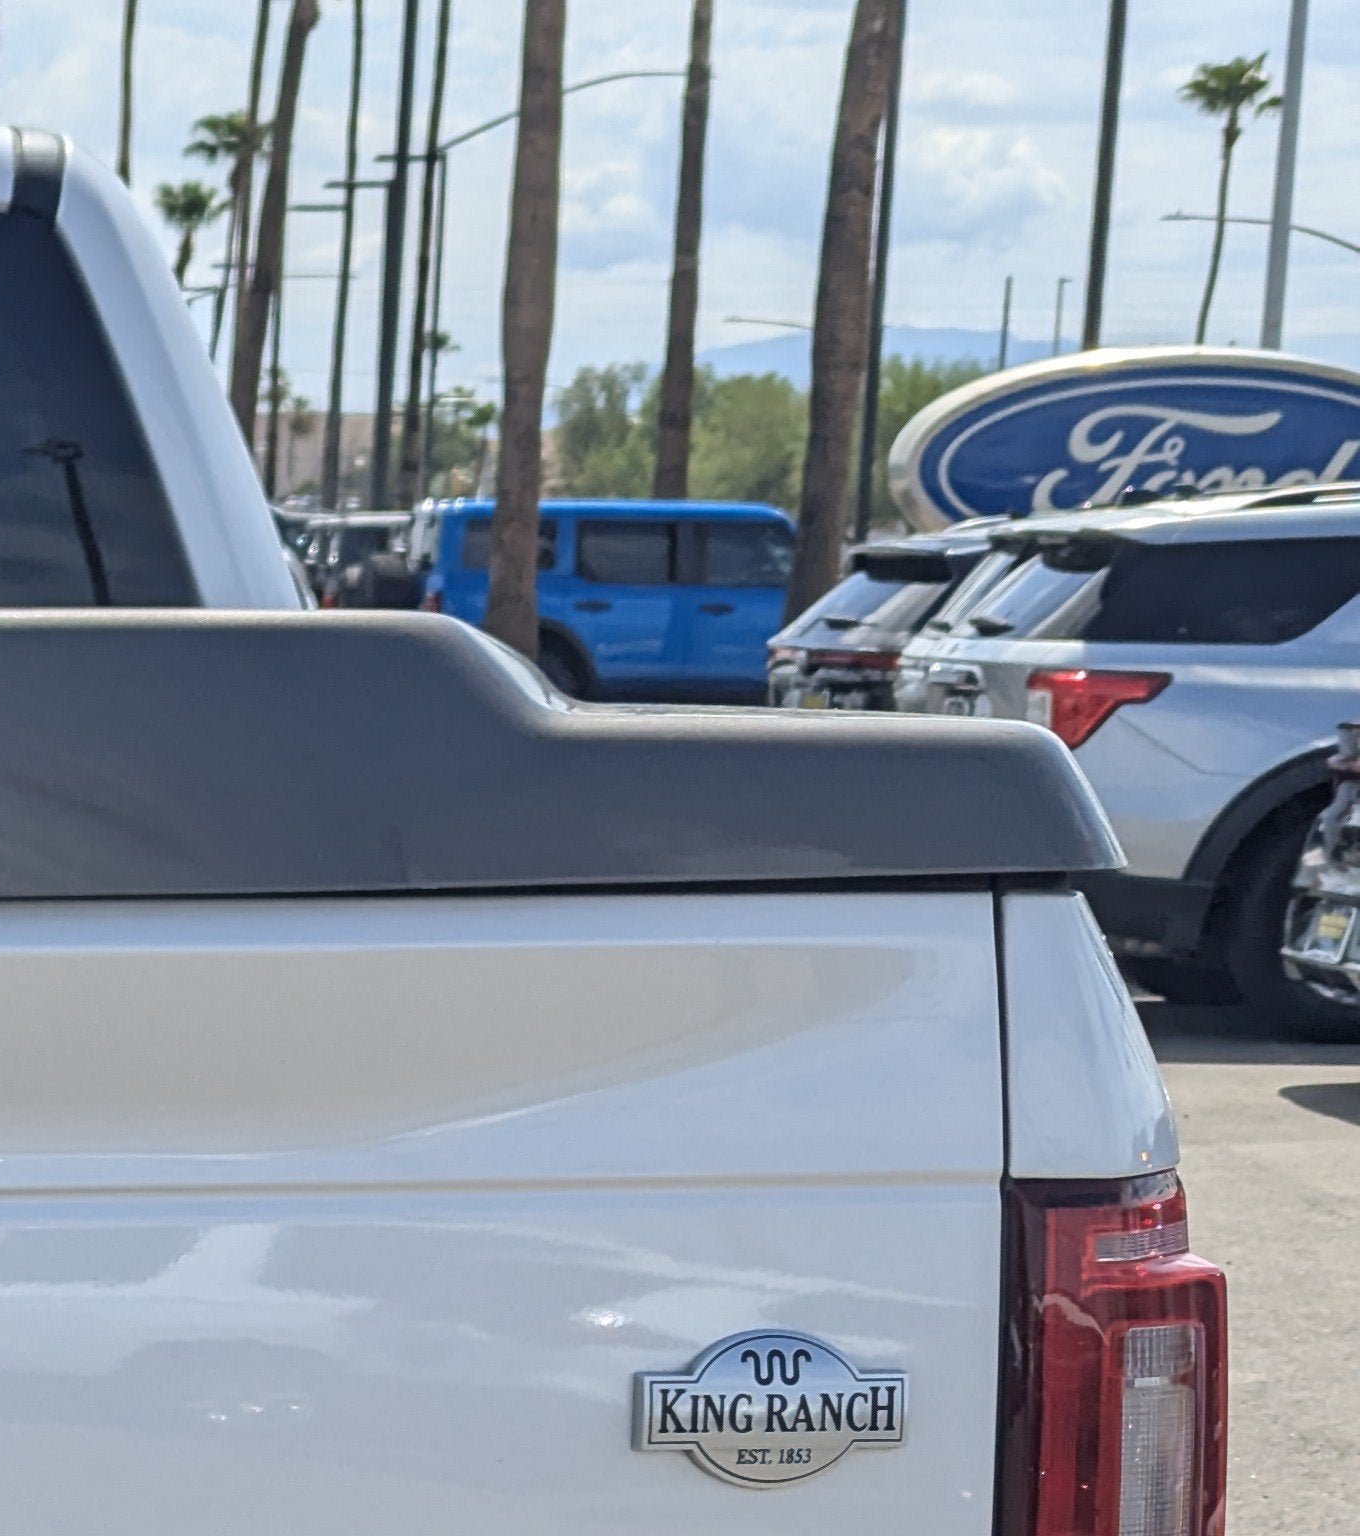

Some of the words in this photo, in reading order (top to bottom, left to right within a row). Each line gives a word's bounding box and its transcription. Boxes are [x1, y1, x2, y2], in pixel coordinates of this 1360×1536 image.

[658, 1387, 754, 1434] KING
[764, 1385, 896, 1434] RANCH
[735, 1448, 773, 1465] EST.
[779, 1447, 813, 1465] 1853
